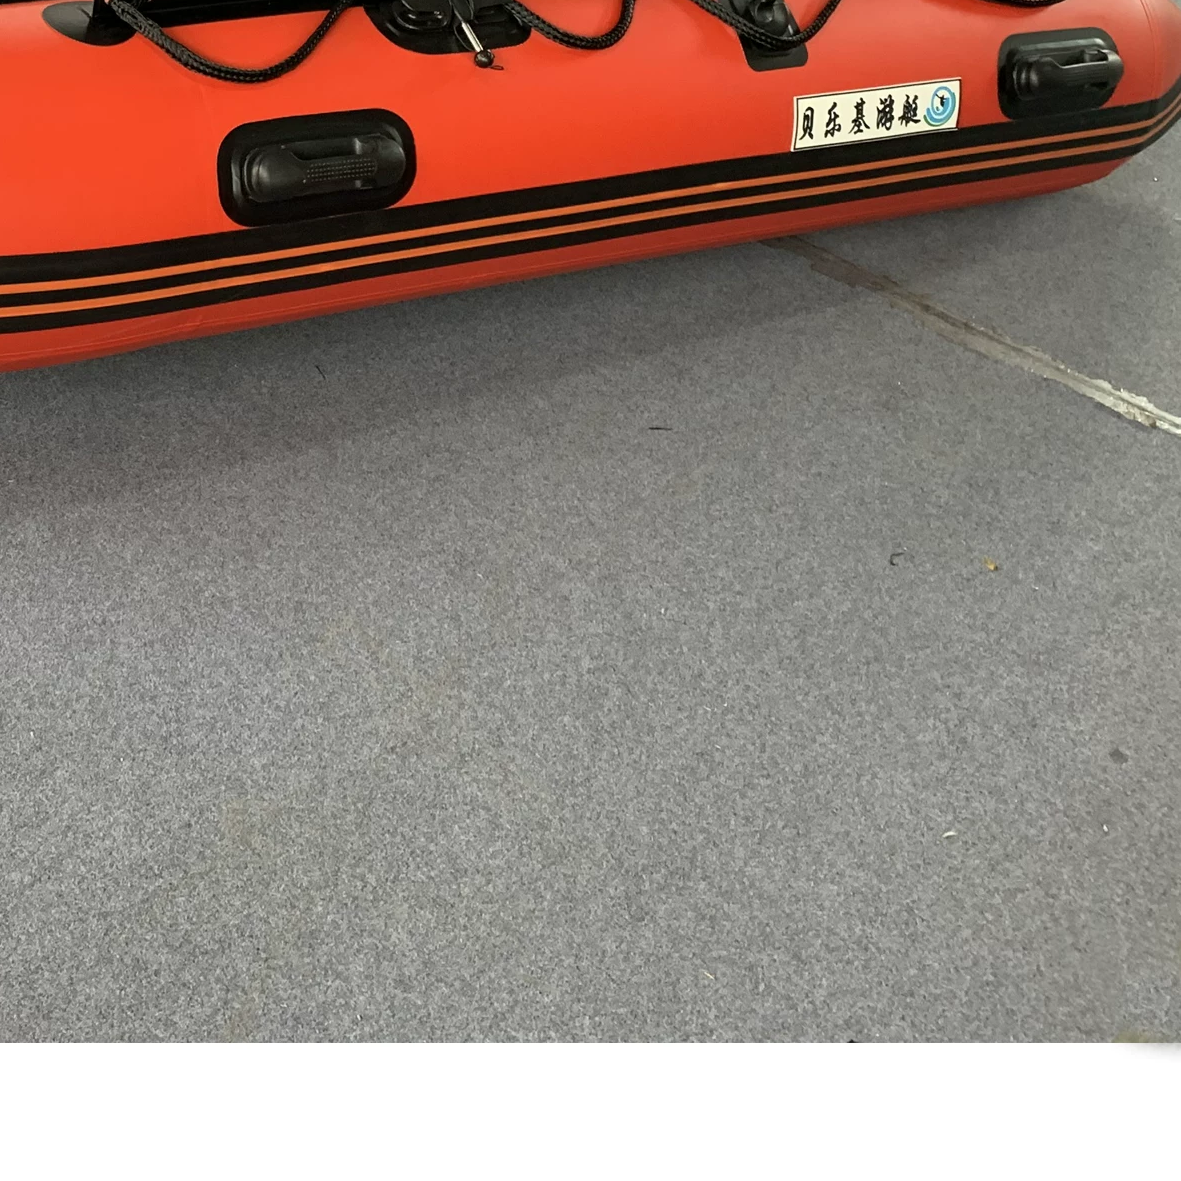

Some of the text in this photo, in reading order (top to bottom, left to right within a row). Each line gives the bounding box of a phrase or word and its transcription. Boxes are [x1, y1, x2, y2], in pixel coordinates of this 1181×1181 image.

[799, 94, 921, 141] 贝乐基游艇
